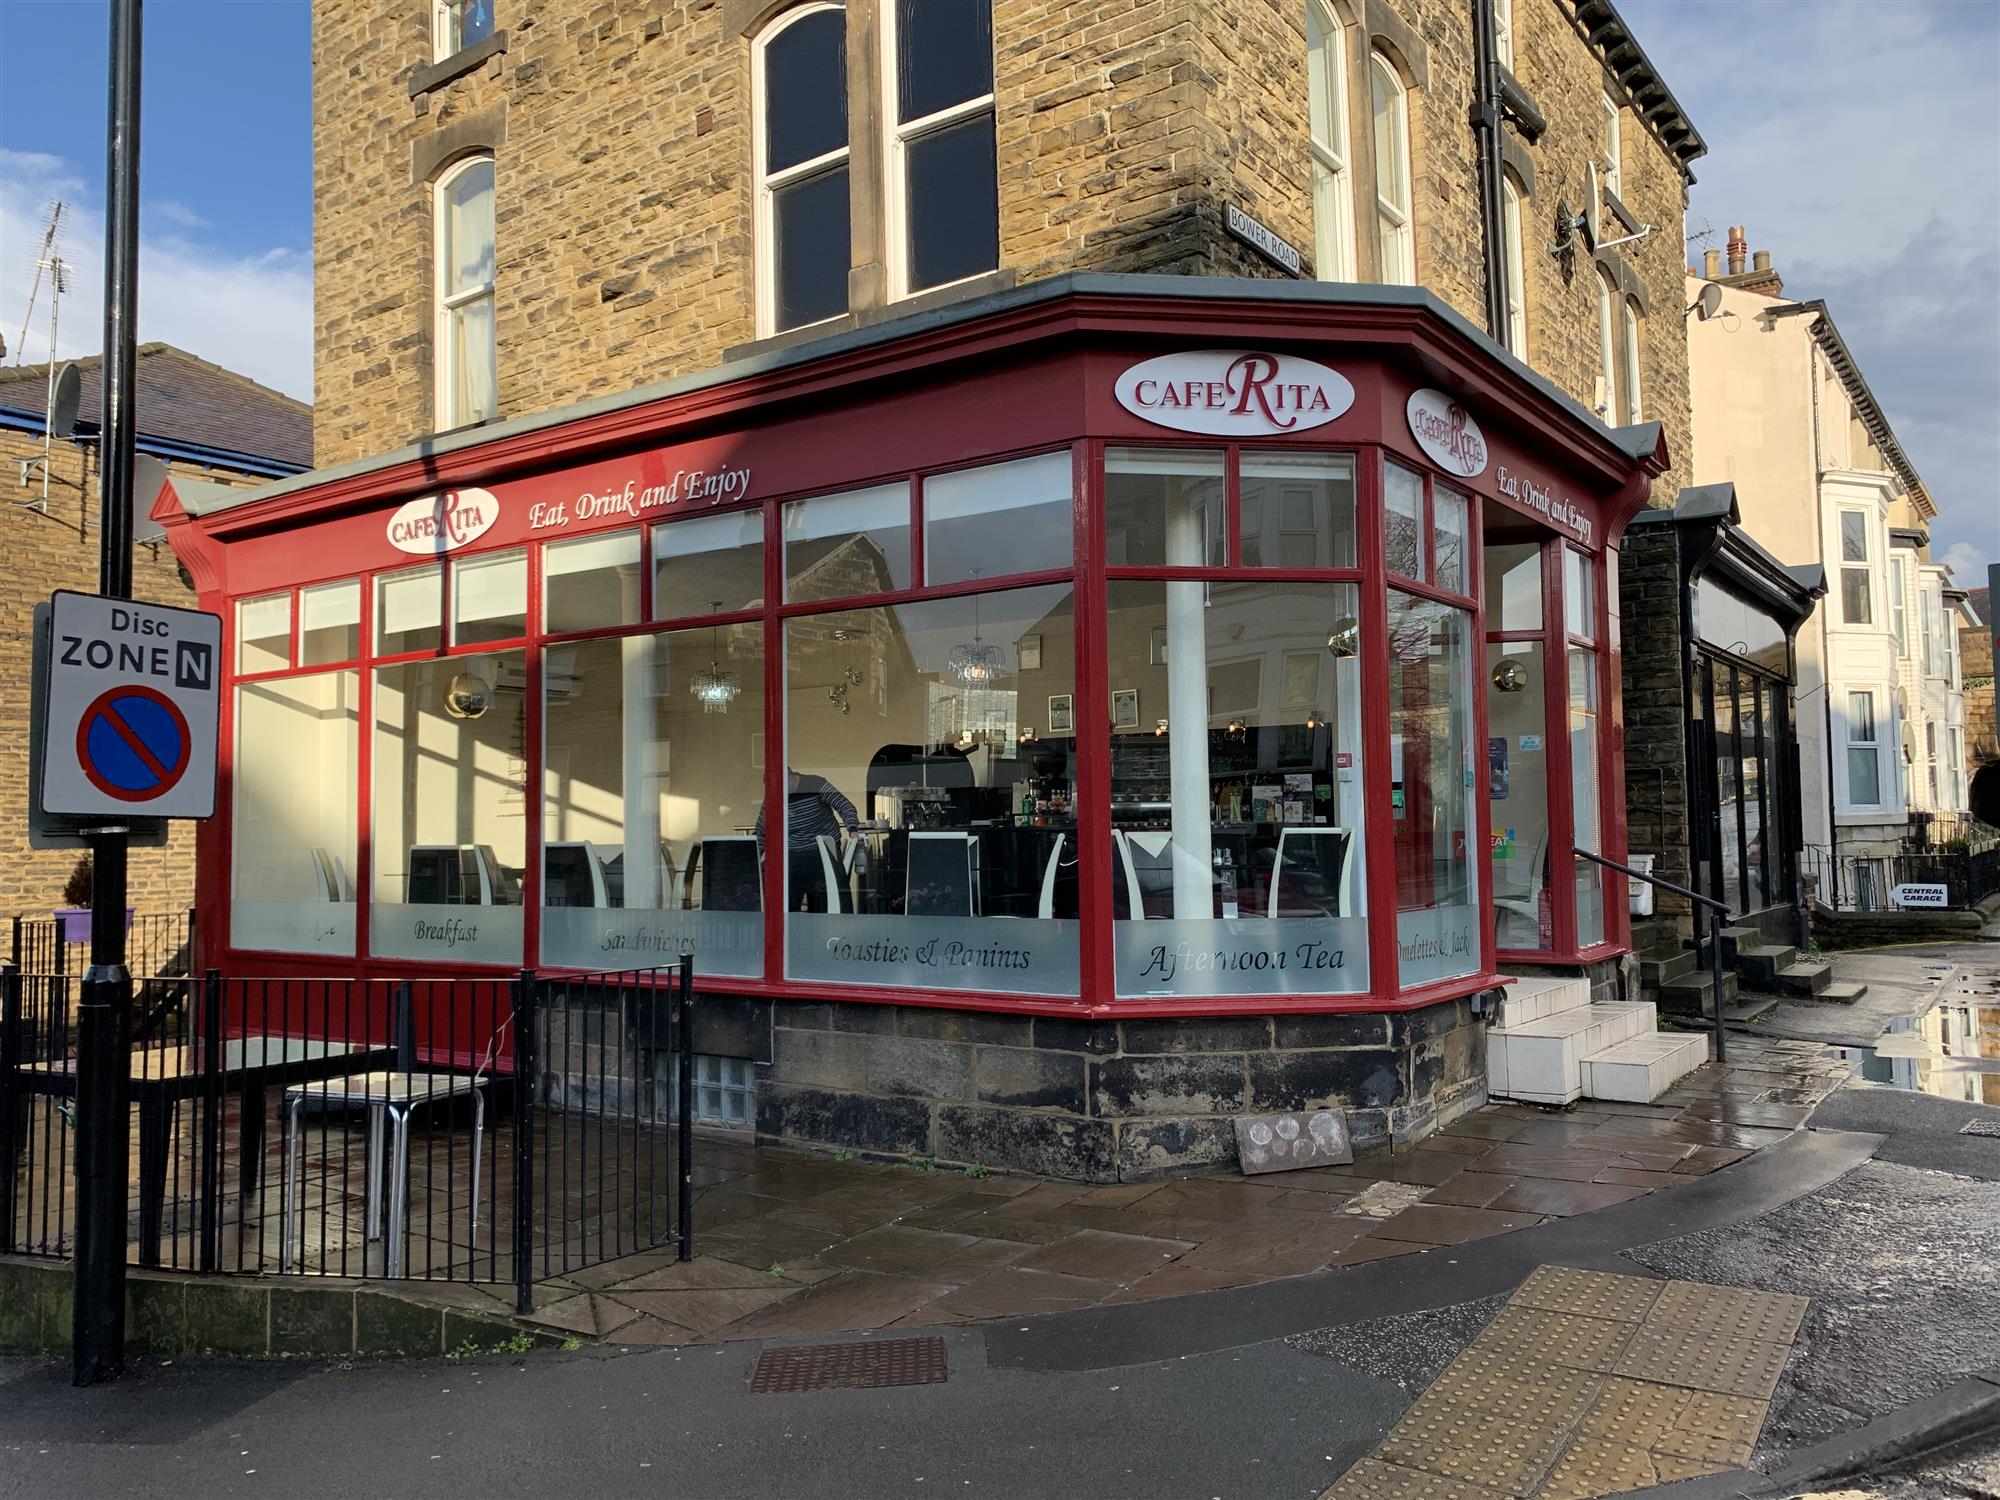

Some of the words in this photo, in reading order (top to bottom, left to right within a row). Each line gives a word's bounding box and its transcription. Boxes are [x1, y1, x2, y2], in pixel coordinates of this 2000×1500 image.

[1231, 208, 1268, 249] BOWER
[1271, 237, 1298, 269] ROAD
[1134, 380, 1227, 409] CAFE
[1225, 352, 1332, 430] RITA
[1414, 408, 1451, 447] CAFE
[1446, 402, 1485, 474] RITA
[391, 515, 435, 544] CAFE
[433, 488, 484, 545] RITA
[529, 502, 569, 530] Eat,
[575, 480, 640, 520] Drink
[640, 470, 685, 509] and
[684, 464, 751, 506] Enjoy
[1497, 466, 1520, 502] Eat,
[1522, 479, 1553, 523] Drink
[1551, 498, 1569, 524] and
[1568, 504, 1592, 545] Enjoy
[111, 607, 170, 638] Disc
[60, 635, 170, 677] ZONE
[181, 649, 205, 682] N
[414, 918, 479, 948] Breakfast
[826, 936, 909, 964] Toasties
[915, 937, 940, 967] &
[944, 941, 1032, 970] Paninis
[1139, 940, 1288, 982] Afternoon
[1296, 940, 1346, 970] Tea
